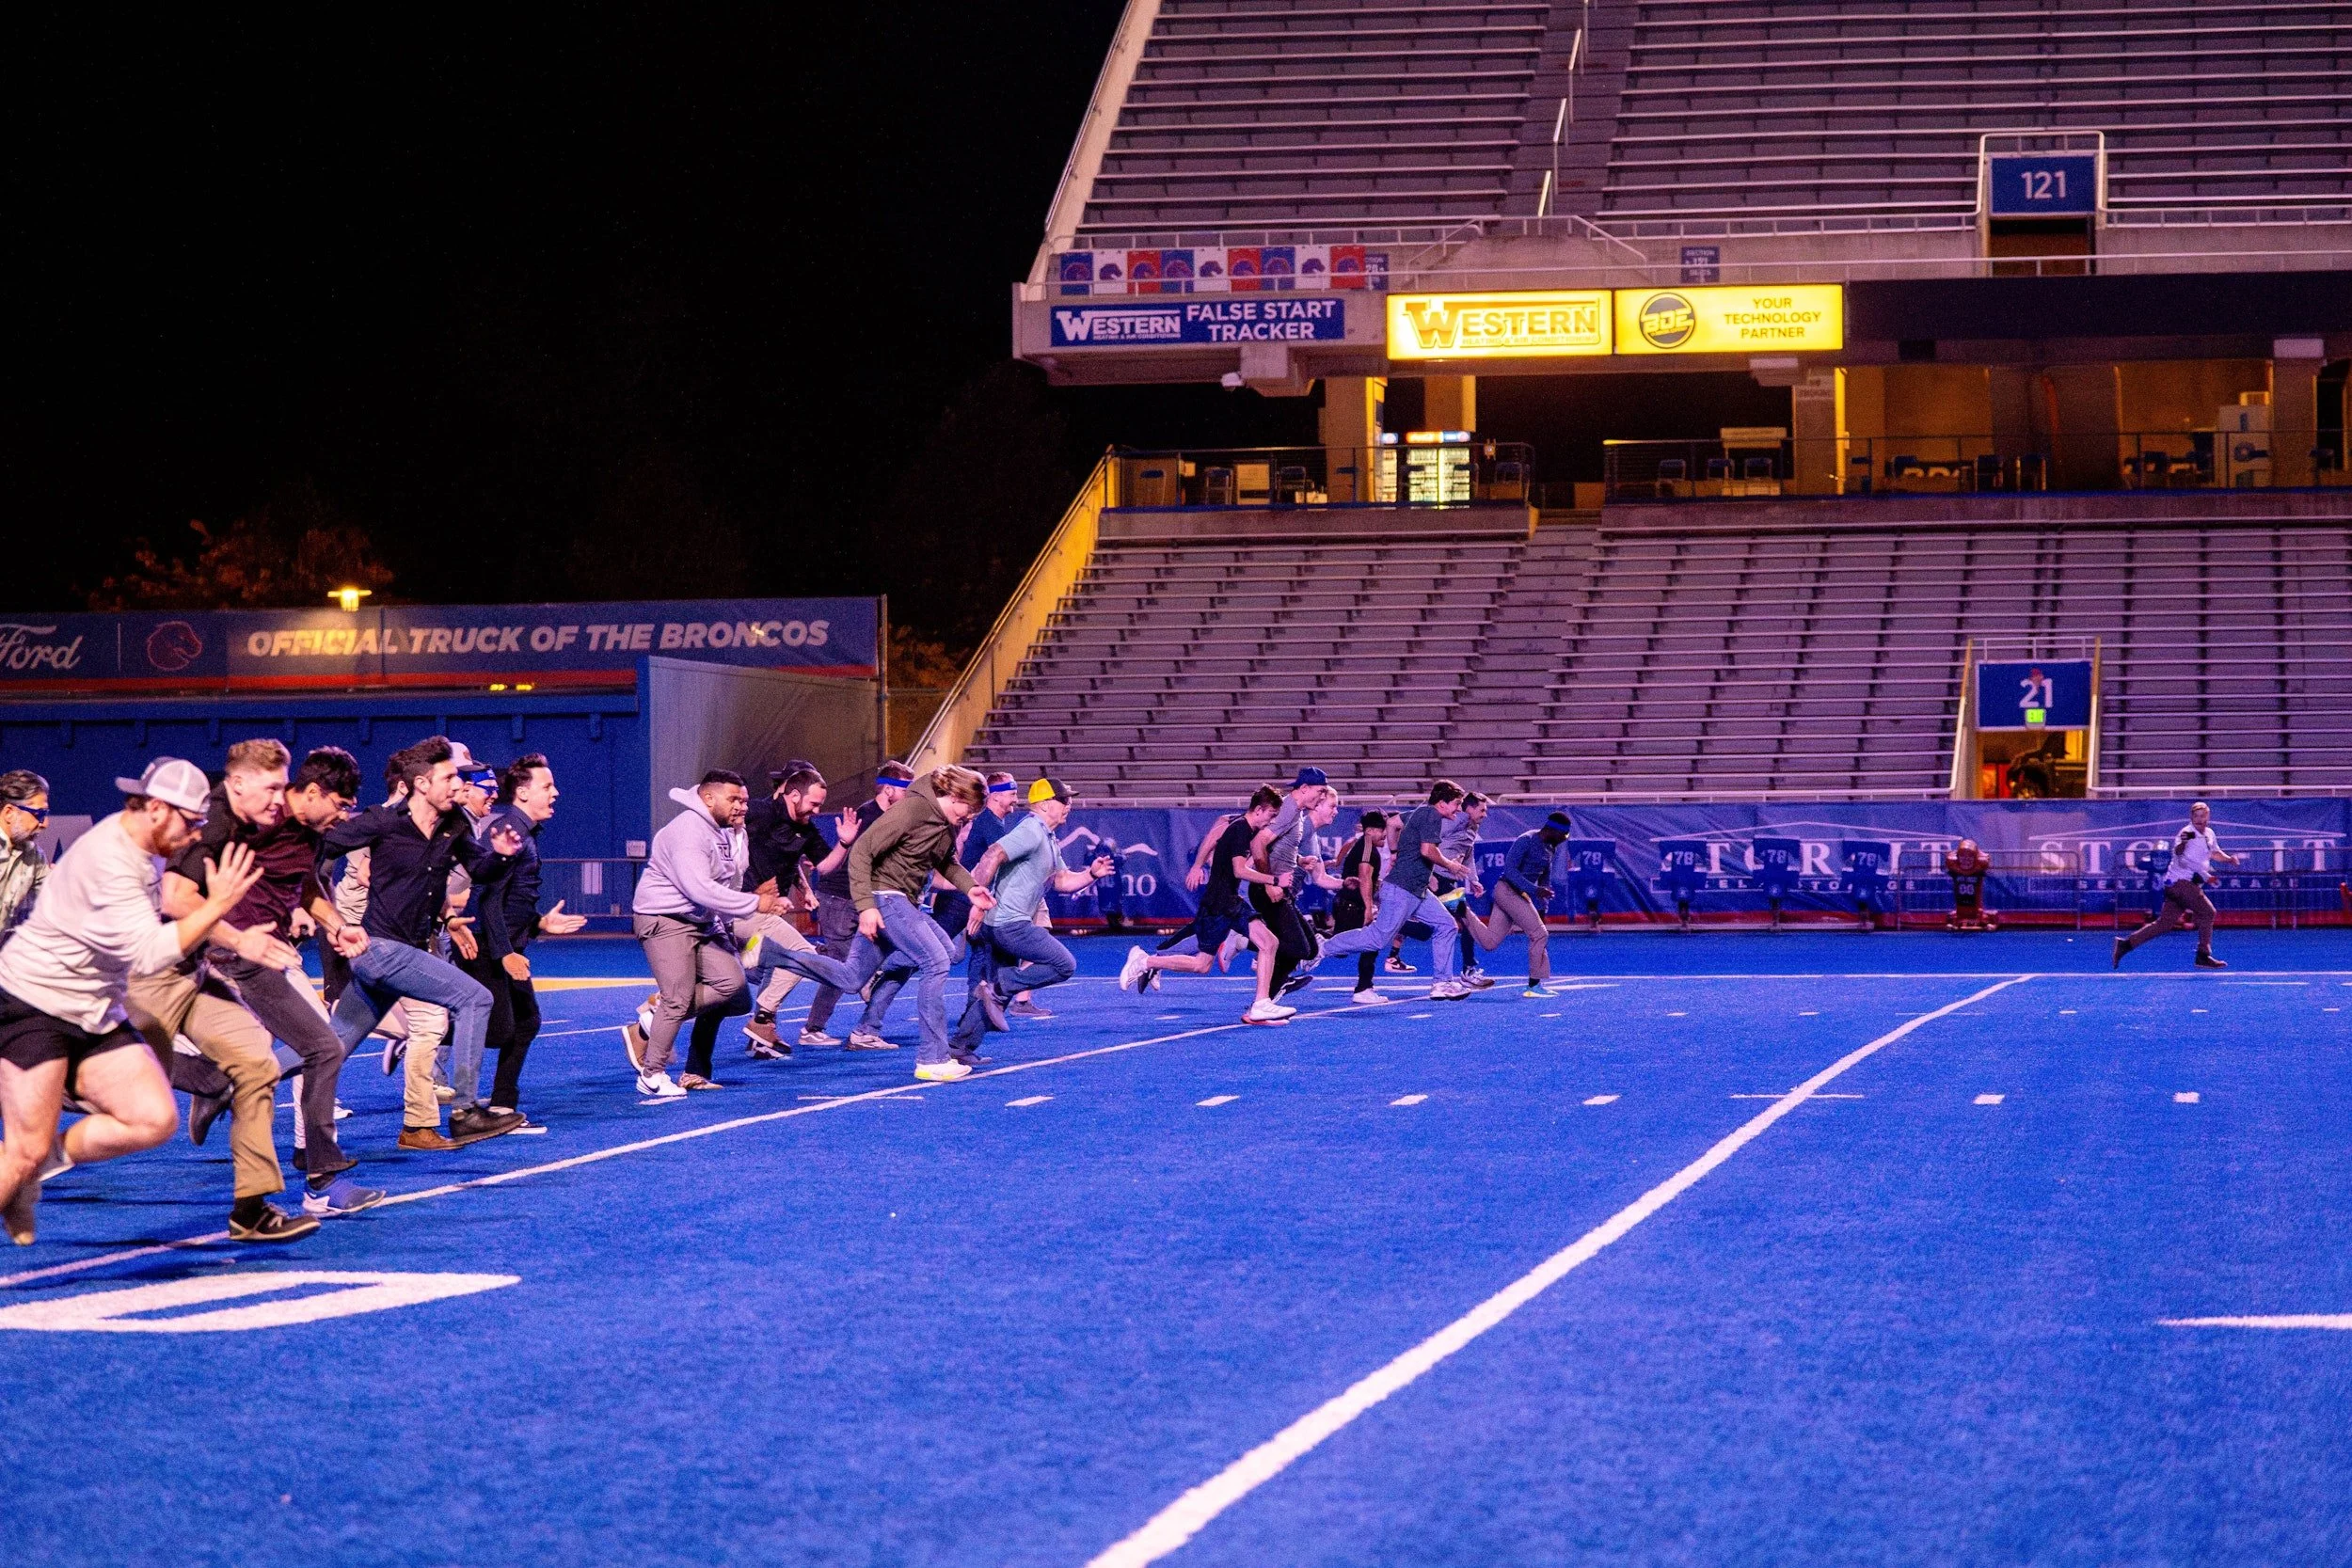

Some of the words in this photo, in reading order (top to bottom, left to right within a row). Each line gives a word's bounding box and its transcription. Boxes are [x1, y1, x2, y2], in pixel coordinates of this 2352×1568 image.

[2021, 171, 2066, 199] 121
[1186, 303, 1258, 323] FALSE
[1263, 300, 1336, 320] START
[1753, 297, 1792, 310] YOUR
[1056, 309, 1182, 341] WESTERN
[1403, 300, 1599, 346] WESTERN
[1724, 311, 1821, 325] TECHNOLOGY
[1208, 322, 1315, 341] TRACKER
[1740, 326, 1804, 340] PARTNER
[0, 623, 83, 670] Ford
[246, 627, 398, 657] OFFICIAL
[407, 626, 525, 655] TRUCK
[530, 625, 580, 653] OF
[586, 623, 656, 651] THE
[659, 619, 830, 650] BRONCOS
[2019, 677, 2054, 708] 21
[1675, 851, 1694, 865] 78
[1767, 849, 1788, 863] 78
